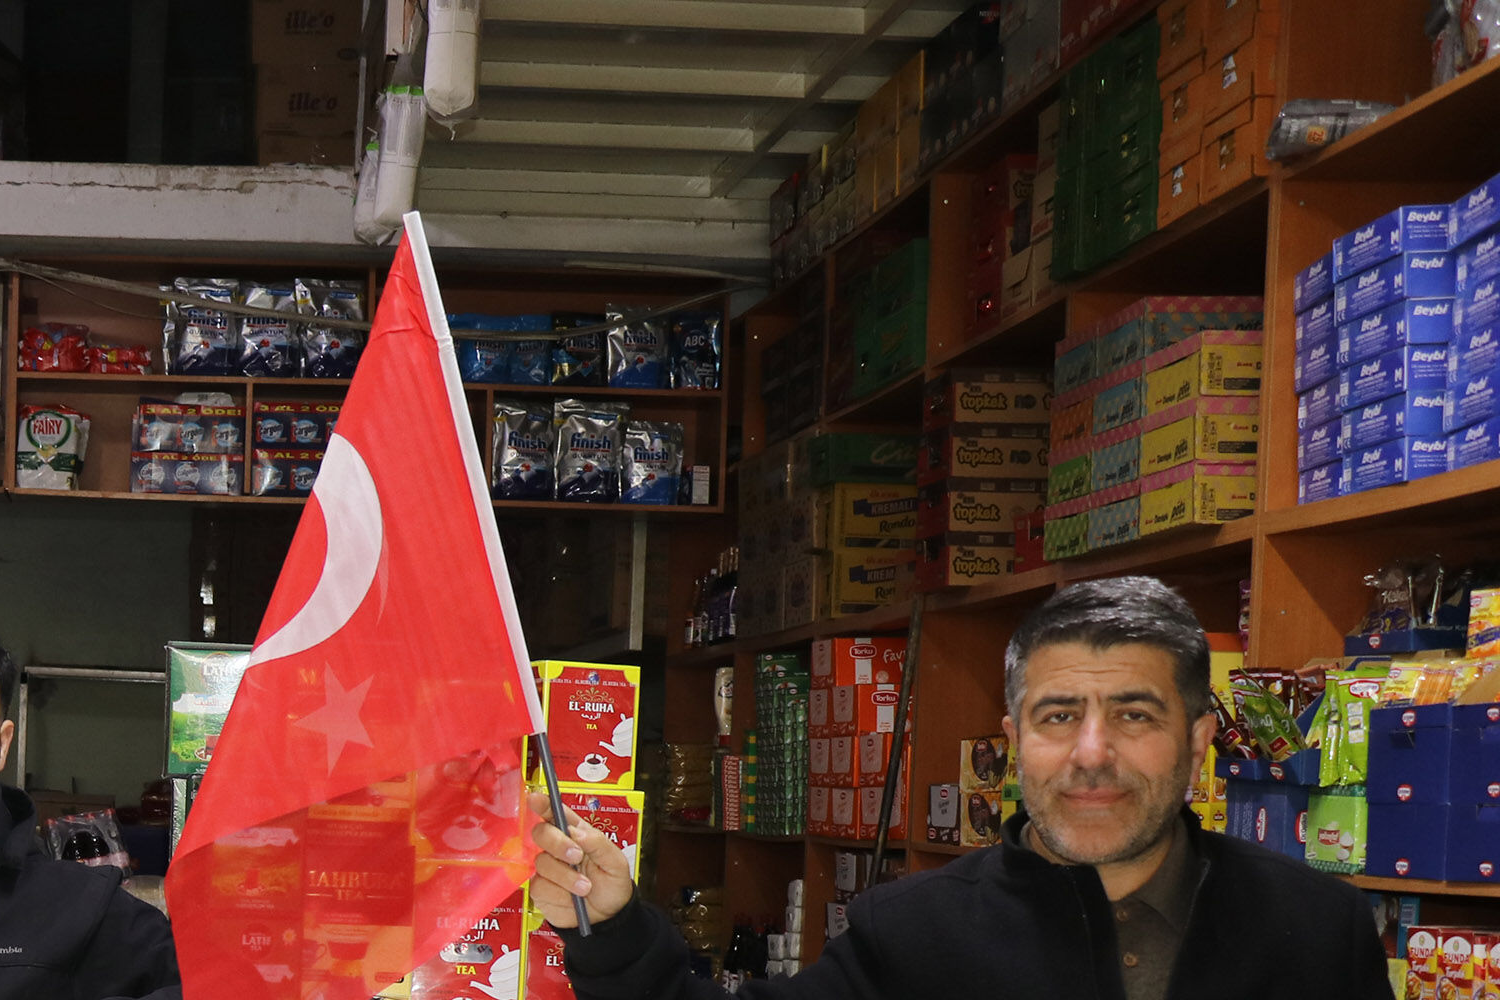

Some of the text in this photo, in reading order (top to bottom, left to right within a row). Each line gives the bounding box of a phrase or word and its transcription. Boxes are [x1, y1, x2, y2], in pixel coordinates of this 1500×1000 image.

[1407, 211, 1442, 222] Beybi
[1411, 258, 1444, 269] Beybi
[1414, 304, 1448, 316] Beybi
[684, 335, 705, 347] ABC
[1412, 350, 1445, 361] Beybi
[960, 393, 1007, 412] topkek
[33, 420, 63, 435] FAIRY
[508, 431, 547, 449] finish
[571, 432, 611, 449] finish
[1412, 441, 1446, 452] Beybi
[634, 447, 669, 462] finish
[957, 448, 1003, 467] topkek
[954, 505, 999, 523] topkek
[880, 516, 915, 533] Rondo
[867, 566, 896, 581] KREM
[954, 558, 999, 576] topkek
[875, 586, 896, 599] Ron
[853, 647, 874, 655] Torku
[876, 693, 896, 702] Torku
[568, 701, 614, 713] EL-RUHA
[456, 965, 476, 975] TEA
